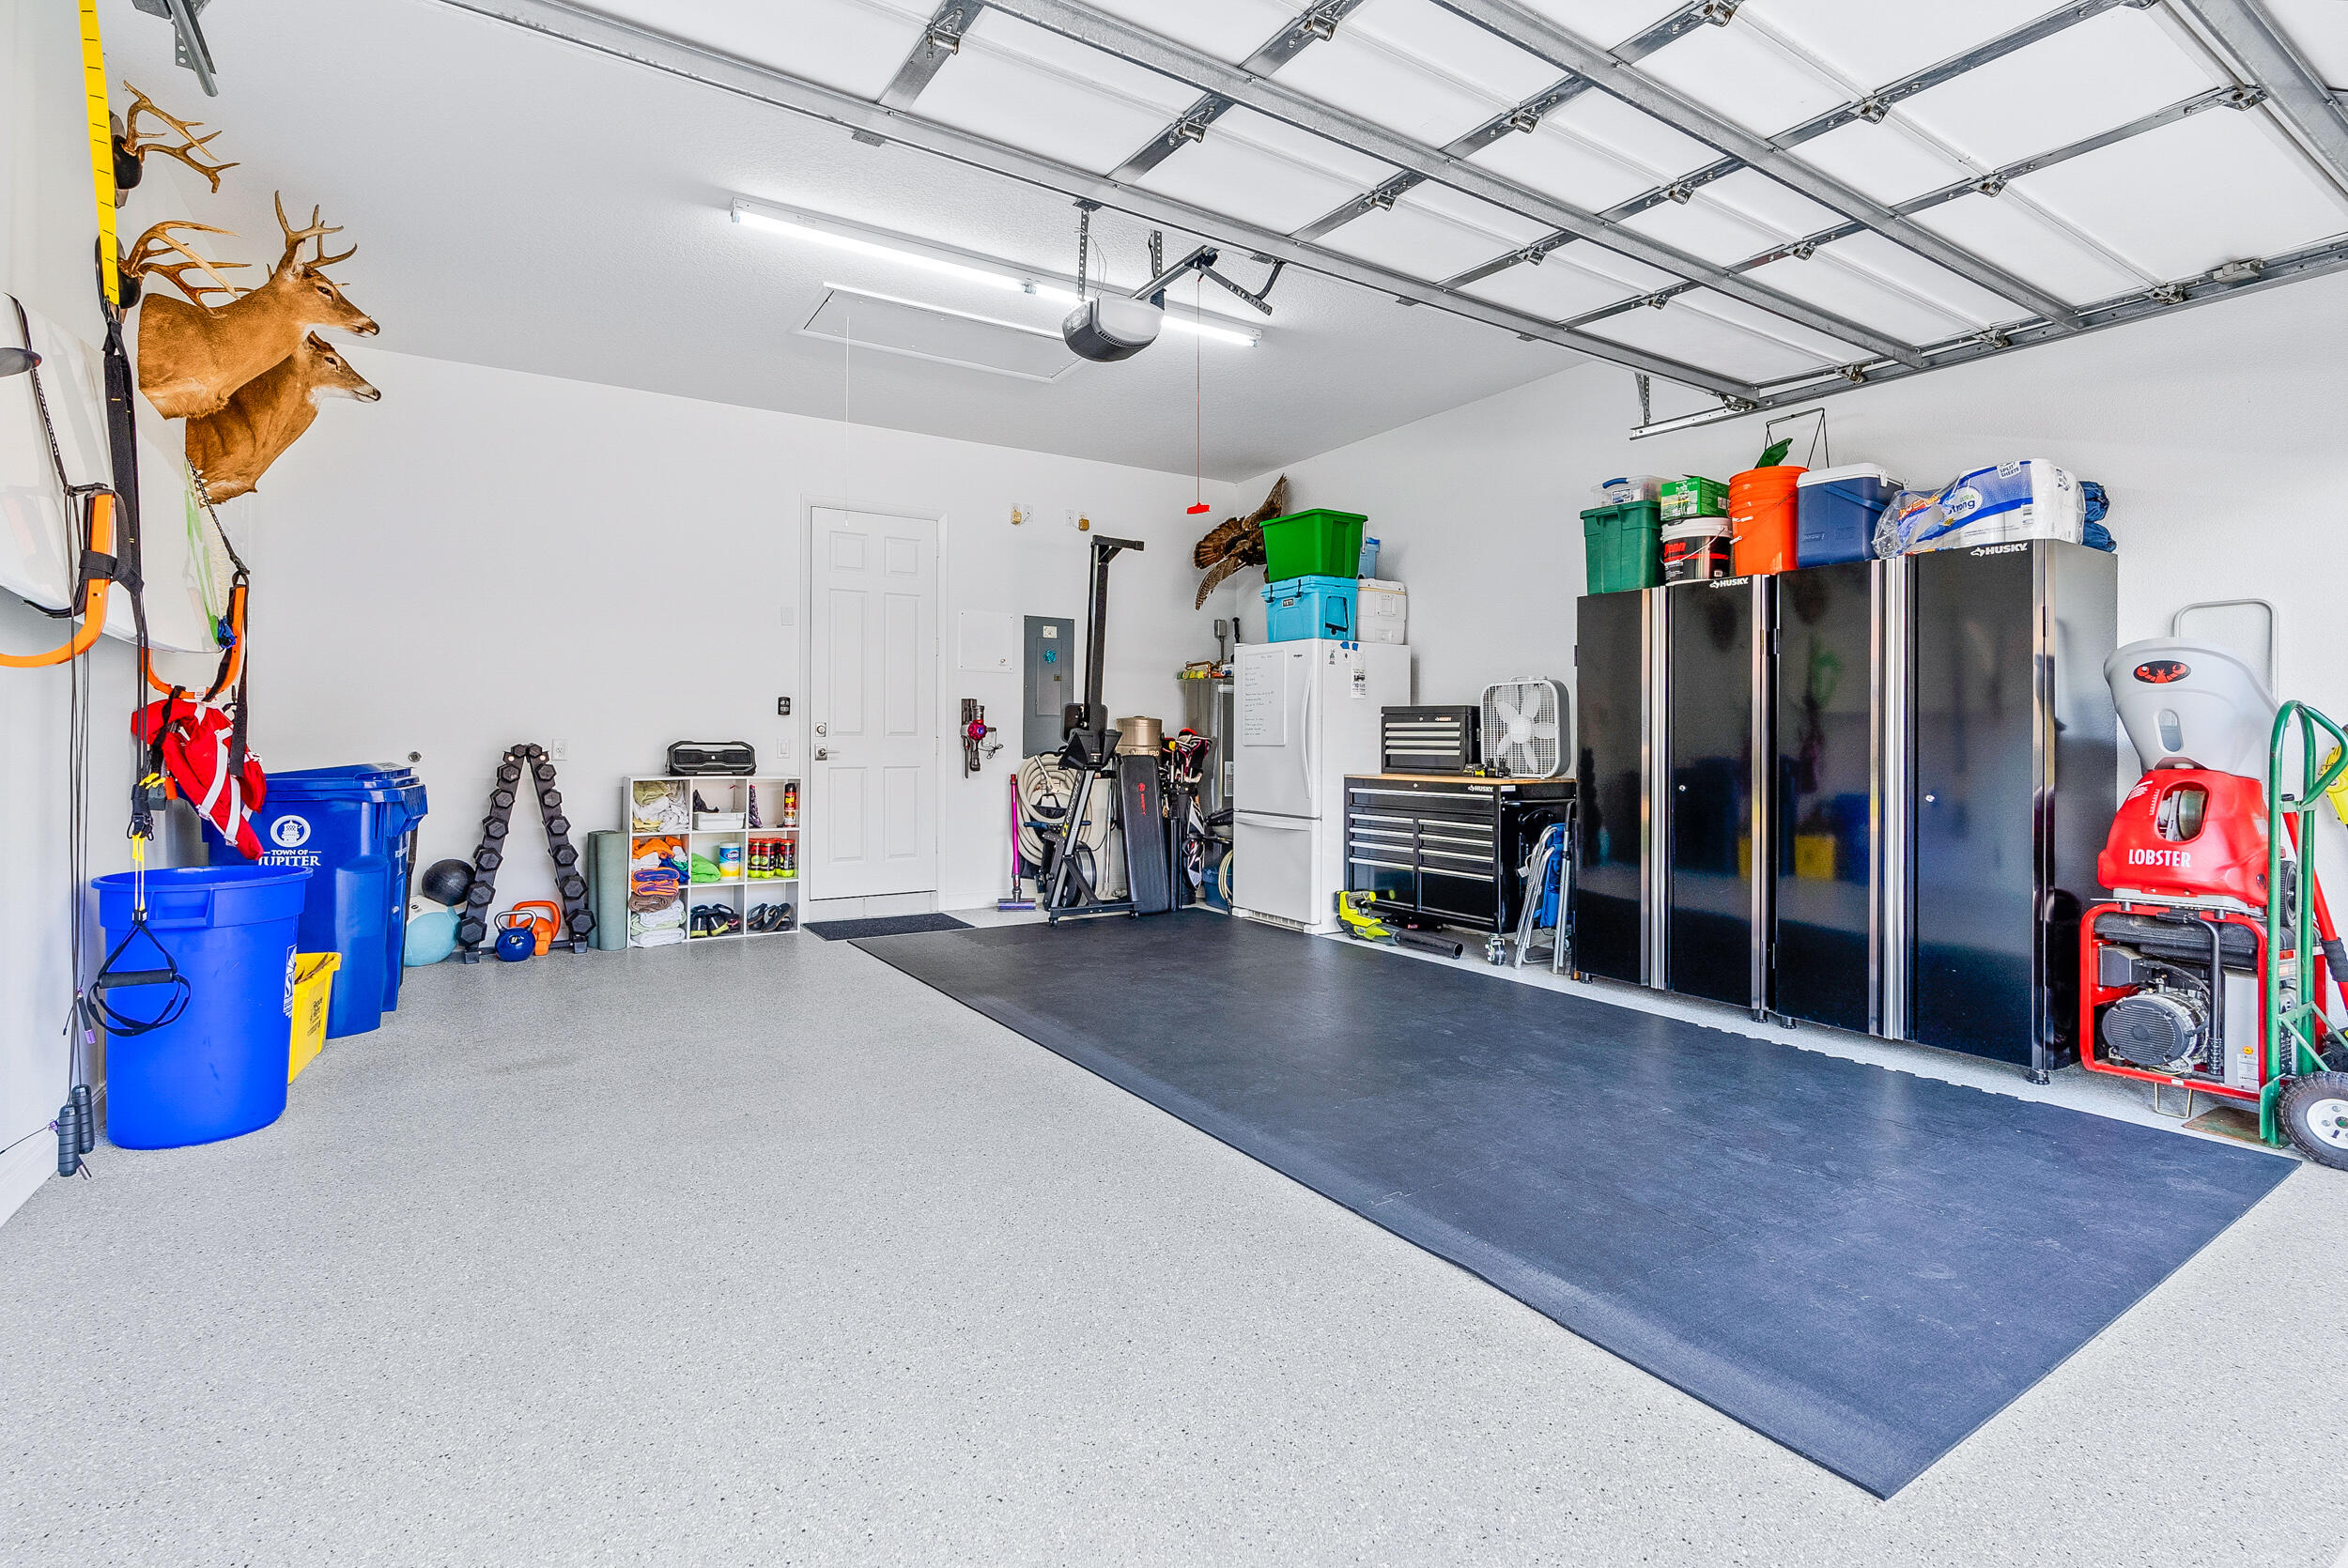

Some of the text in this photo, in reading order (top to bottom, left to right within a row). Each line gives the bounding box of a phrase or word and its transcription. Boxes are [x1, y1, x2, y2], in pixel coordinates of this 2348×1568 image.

[1985, 542, 2028, 556] HUSKY
[1720, 576, 1749, 587] HUSKY
[1474, 785, 1494, 793] HUSKY
[258, 855, 321, 866] JUPITER
[2128, 848, 2192, 869] LOBSTER
